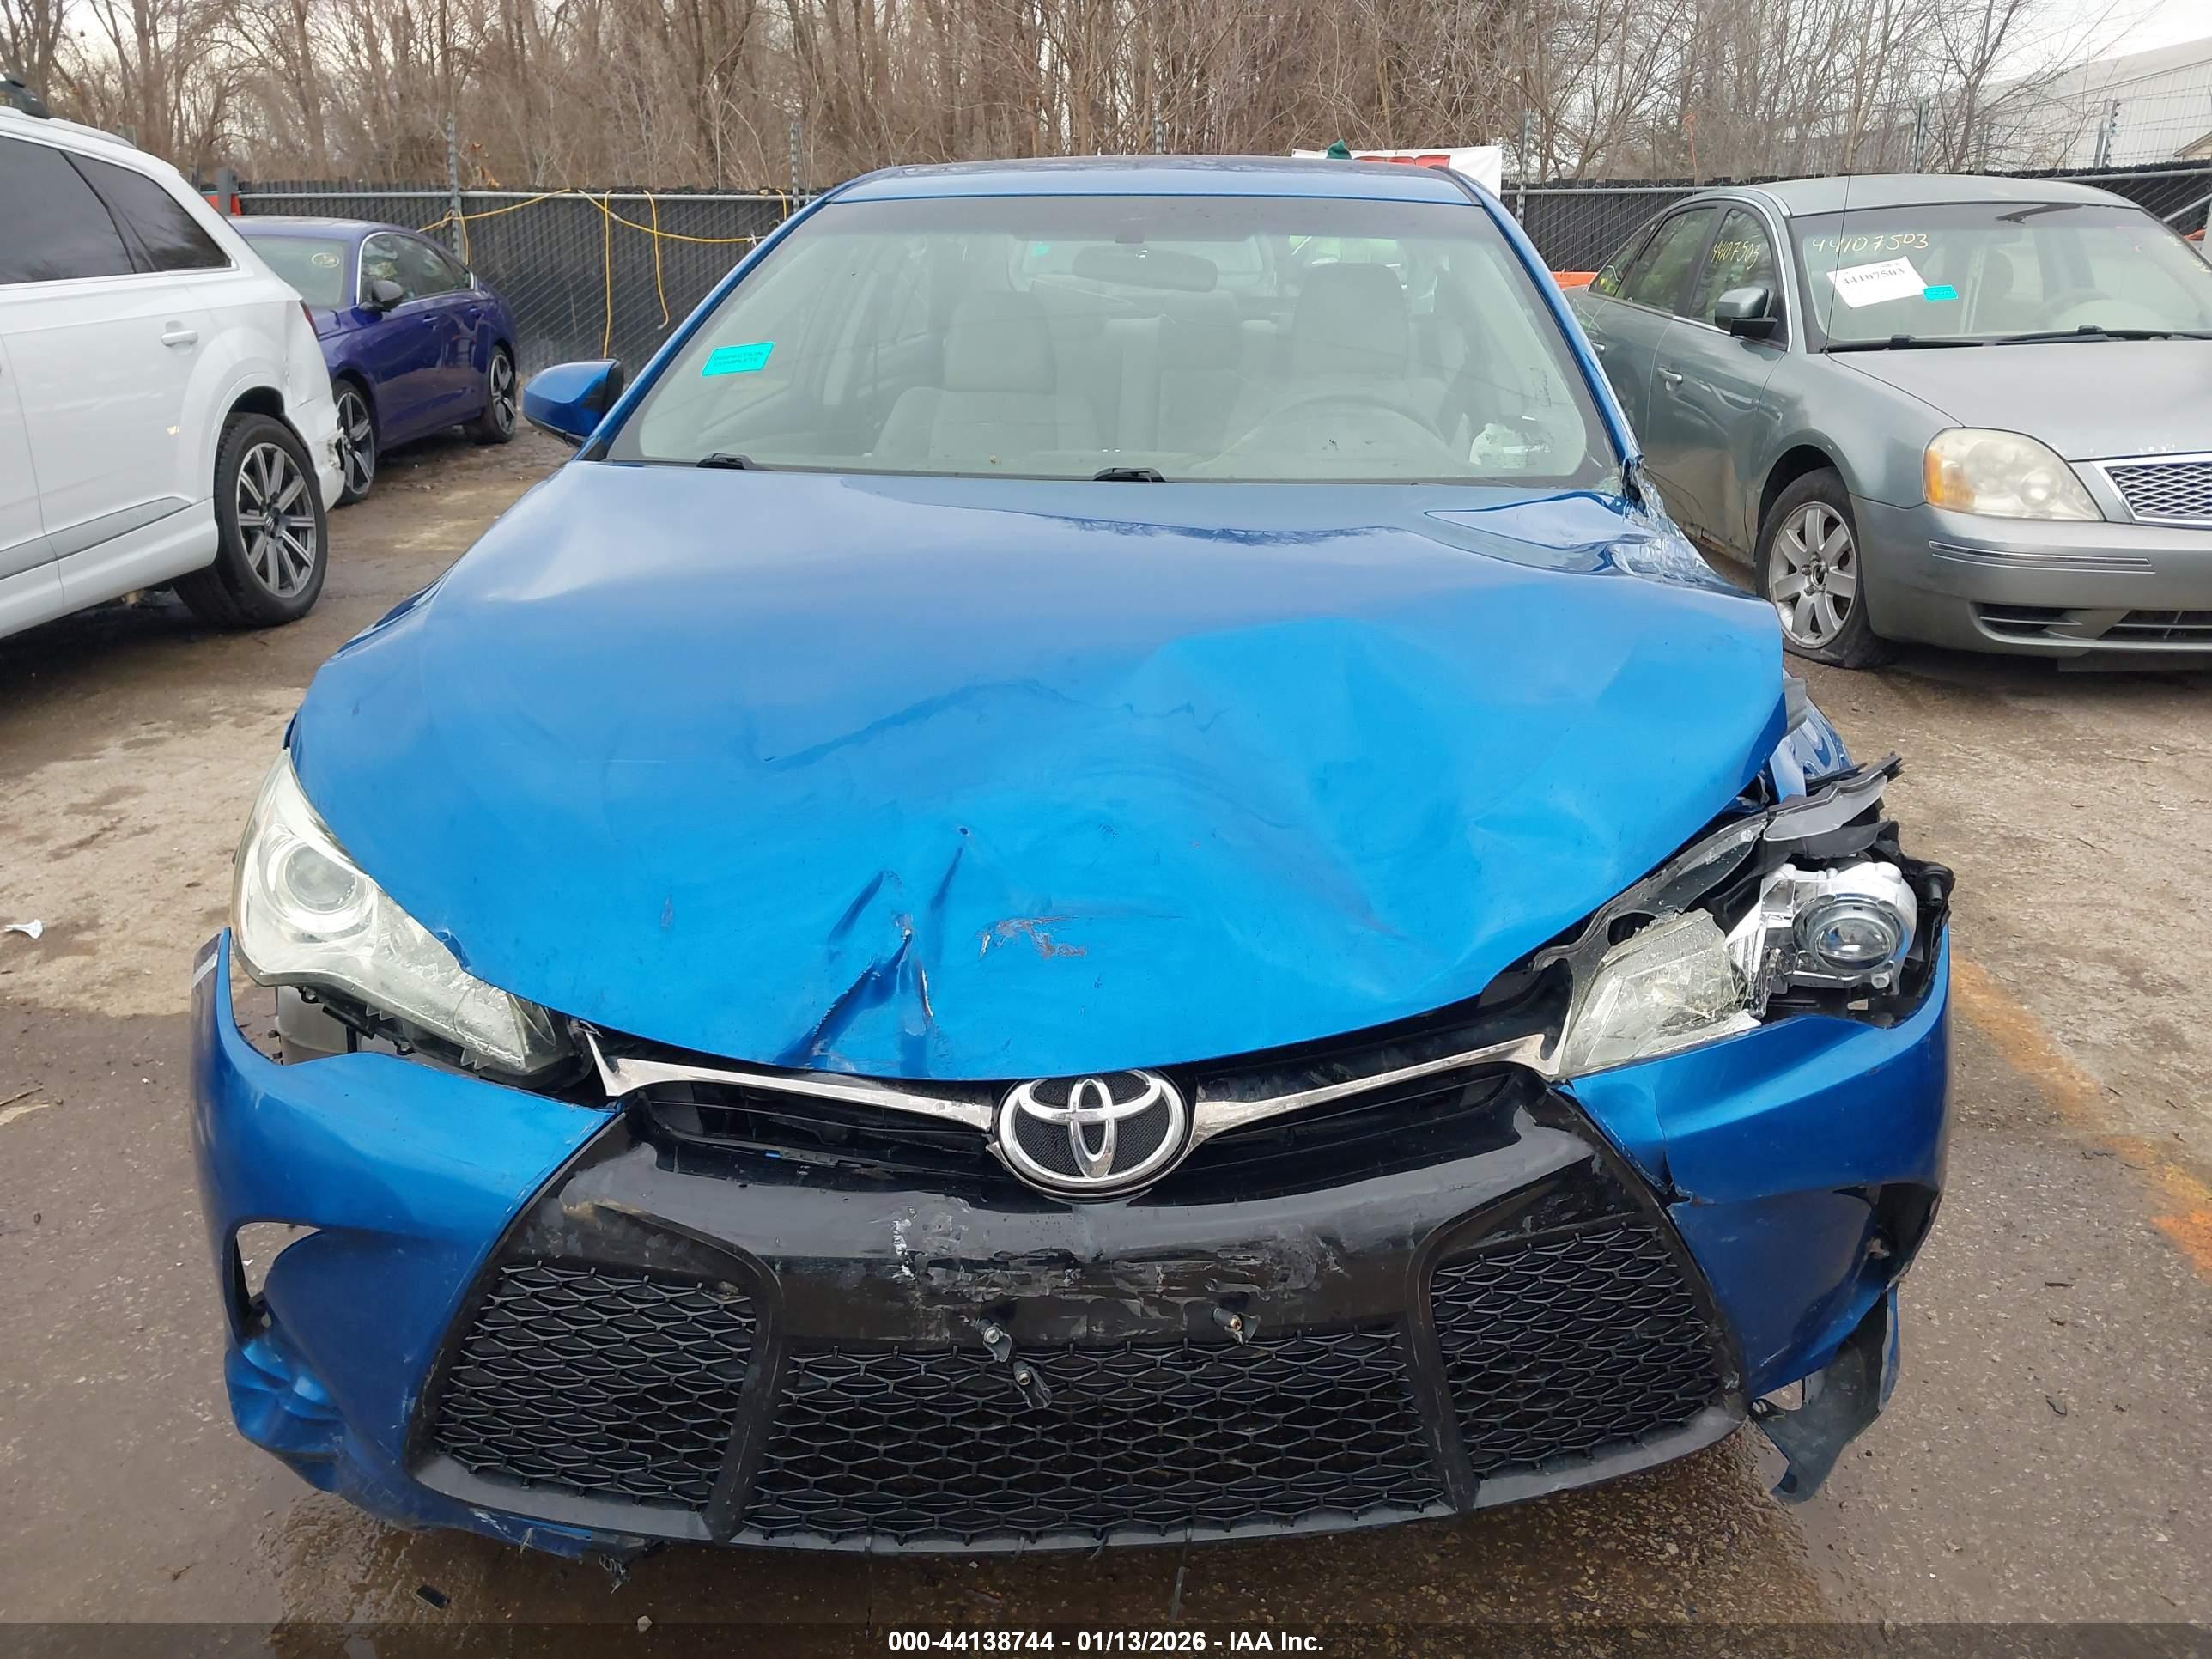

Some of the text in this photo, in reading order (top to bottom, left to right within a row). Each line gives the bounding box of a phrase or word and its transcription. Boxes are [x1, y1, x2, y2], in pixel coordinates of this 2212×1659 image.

[1813, 234, 1929, 253] 44107503
[1711, 240, 1760, 270] 44107503
[1842, 267, 1905, 285] 44107503
